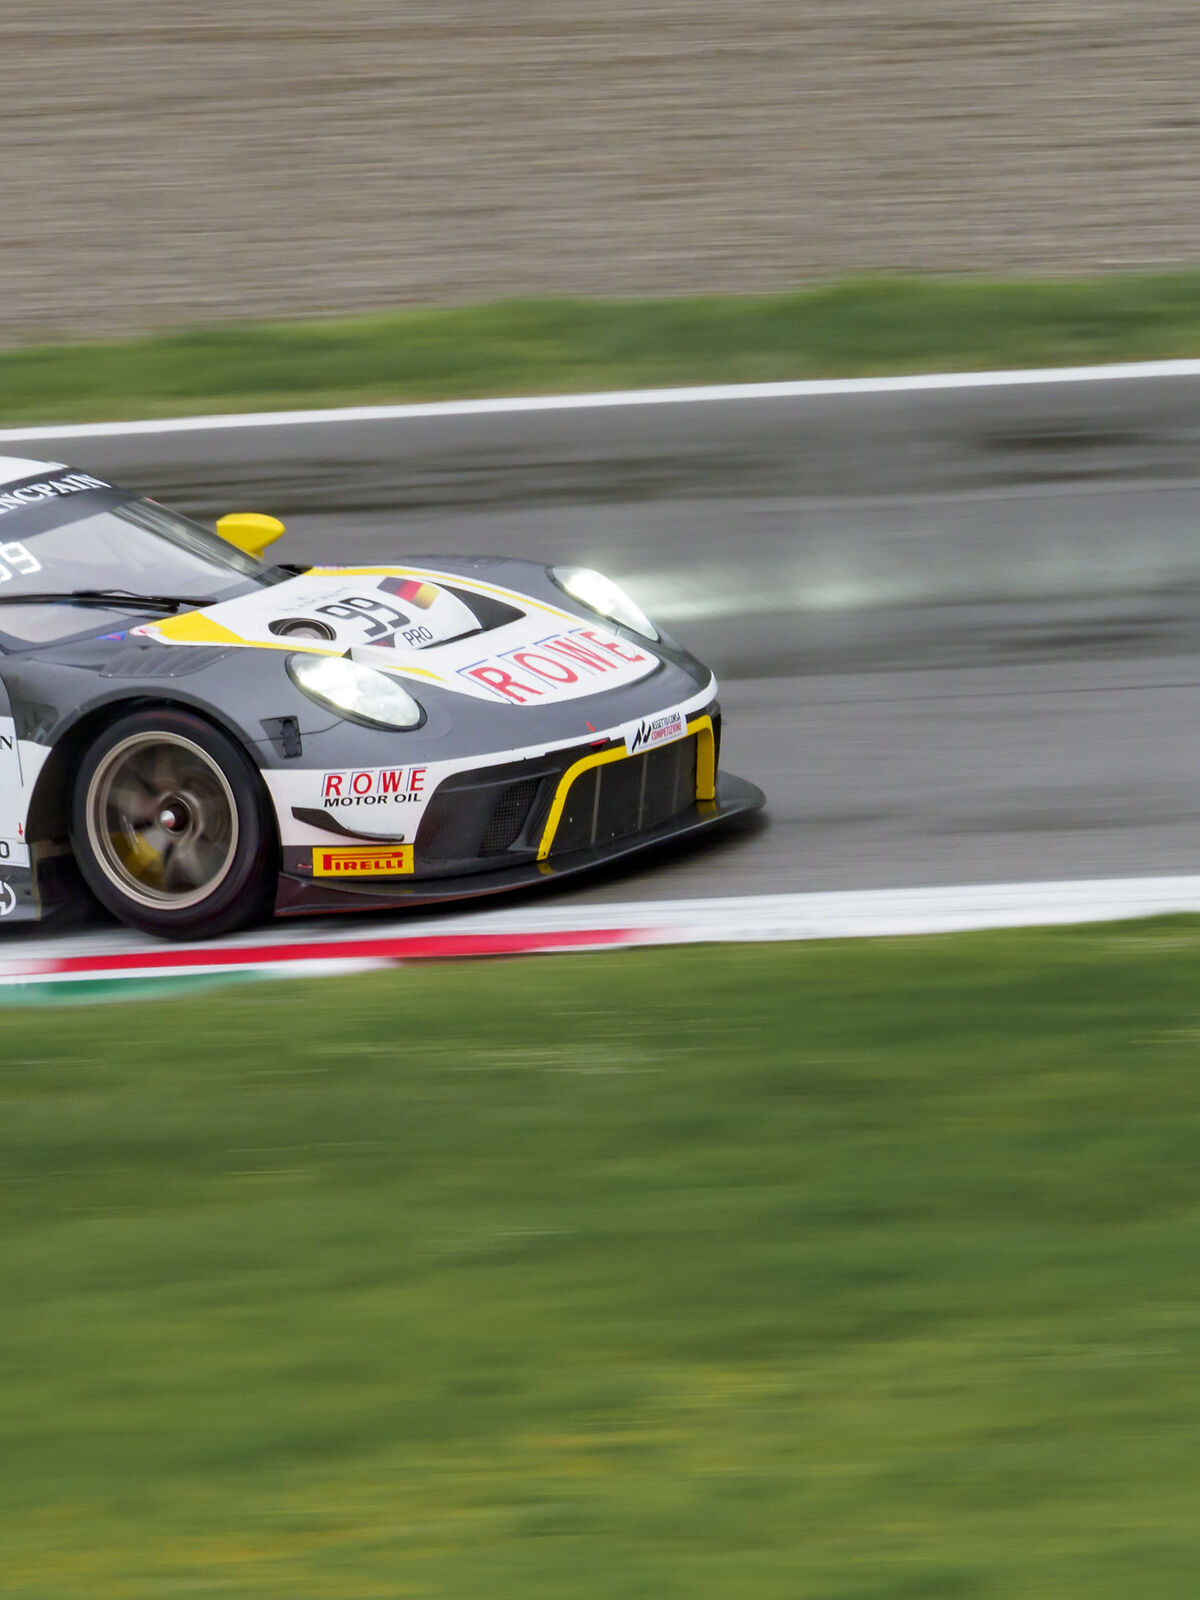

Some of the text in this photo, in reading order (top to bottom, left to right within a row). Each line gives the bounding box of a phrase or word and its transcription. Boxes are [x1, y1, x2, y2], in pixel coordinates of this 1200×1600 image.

[315, 597, 411, 637] 99
[401, 626, 434, 648] PRO
[468, 631, 646, 704] ROWE
[325, 769, 426, 797] ROWE
[324, 793, 422, 808] MOTOR OIL
[322, 851, 404, 871] PIRELLI
